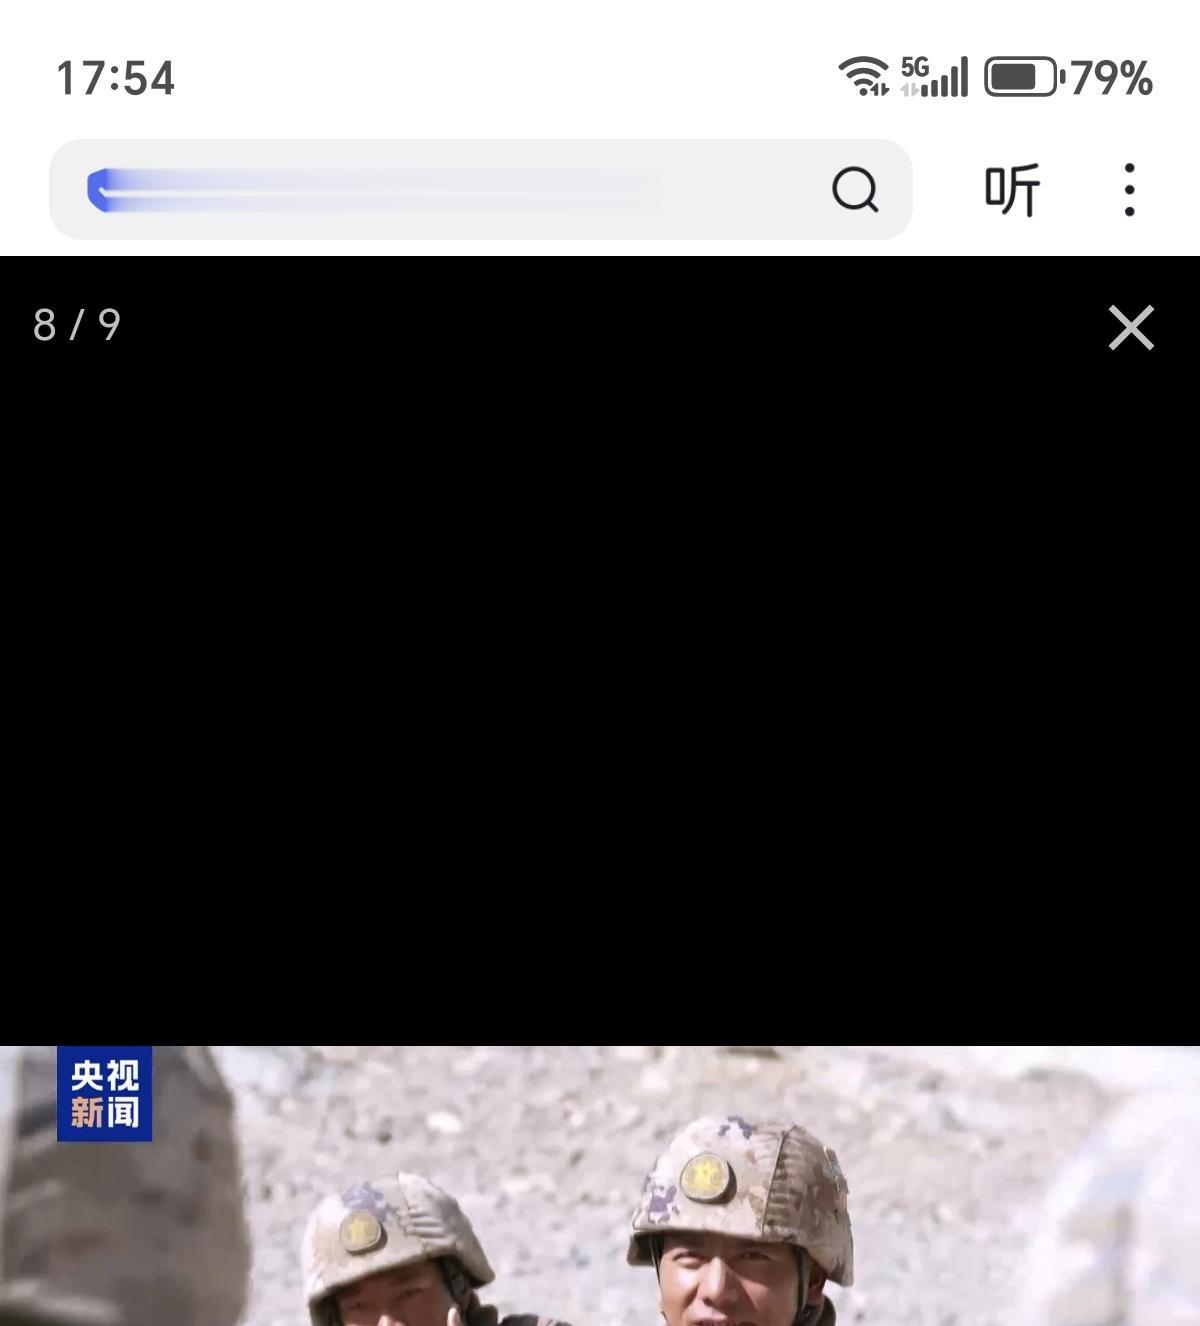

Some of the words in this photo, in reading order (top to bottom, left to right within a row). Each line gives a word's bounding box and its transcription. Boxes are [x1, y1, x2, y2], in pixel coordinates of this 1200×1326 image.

[58, 60, 175, 96] 17:54
[901, 56, 930, 77] 5G
[1070, 60, 1154, 96] 79%
[985, 163, 1041, 218] 听
[33, 308, 56, 341] 8
[98, 308, 121, 341] 9
